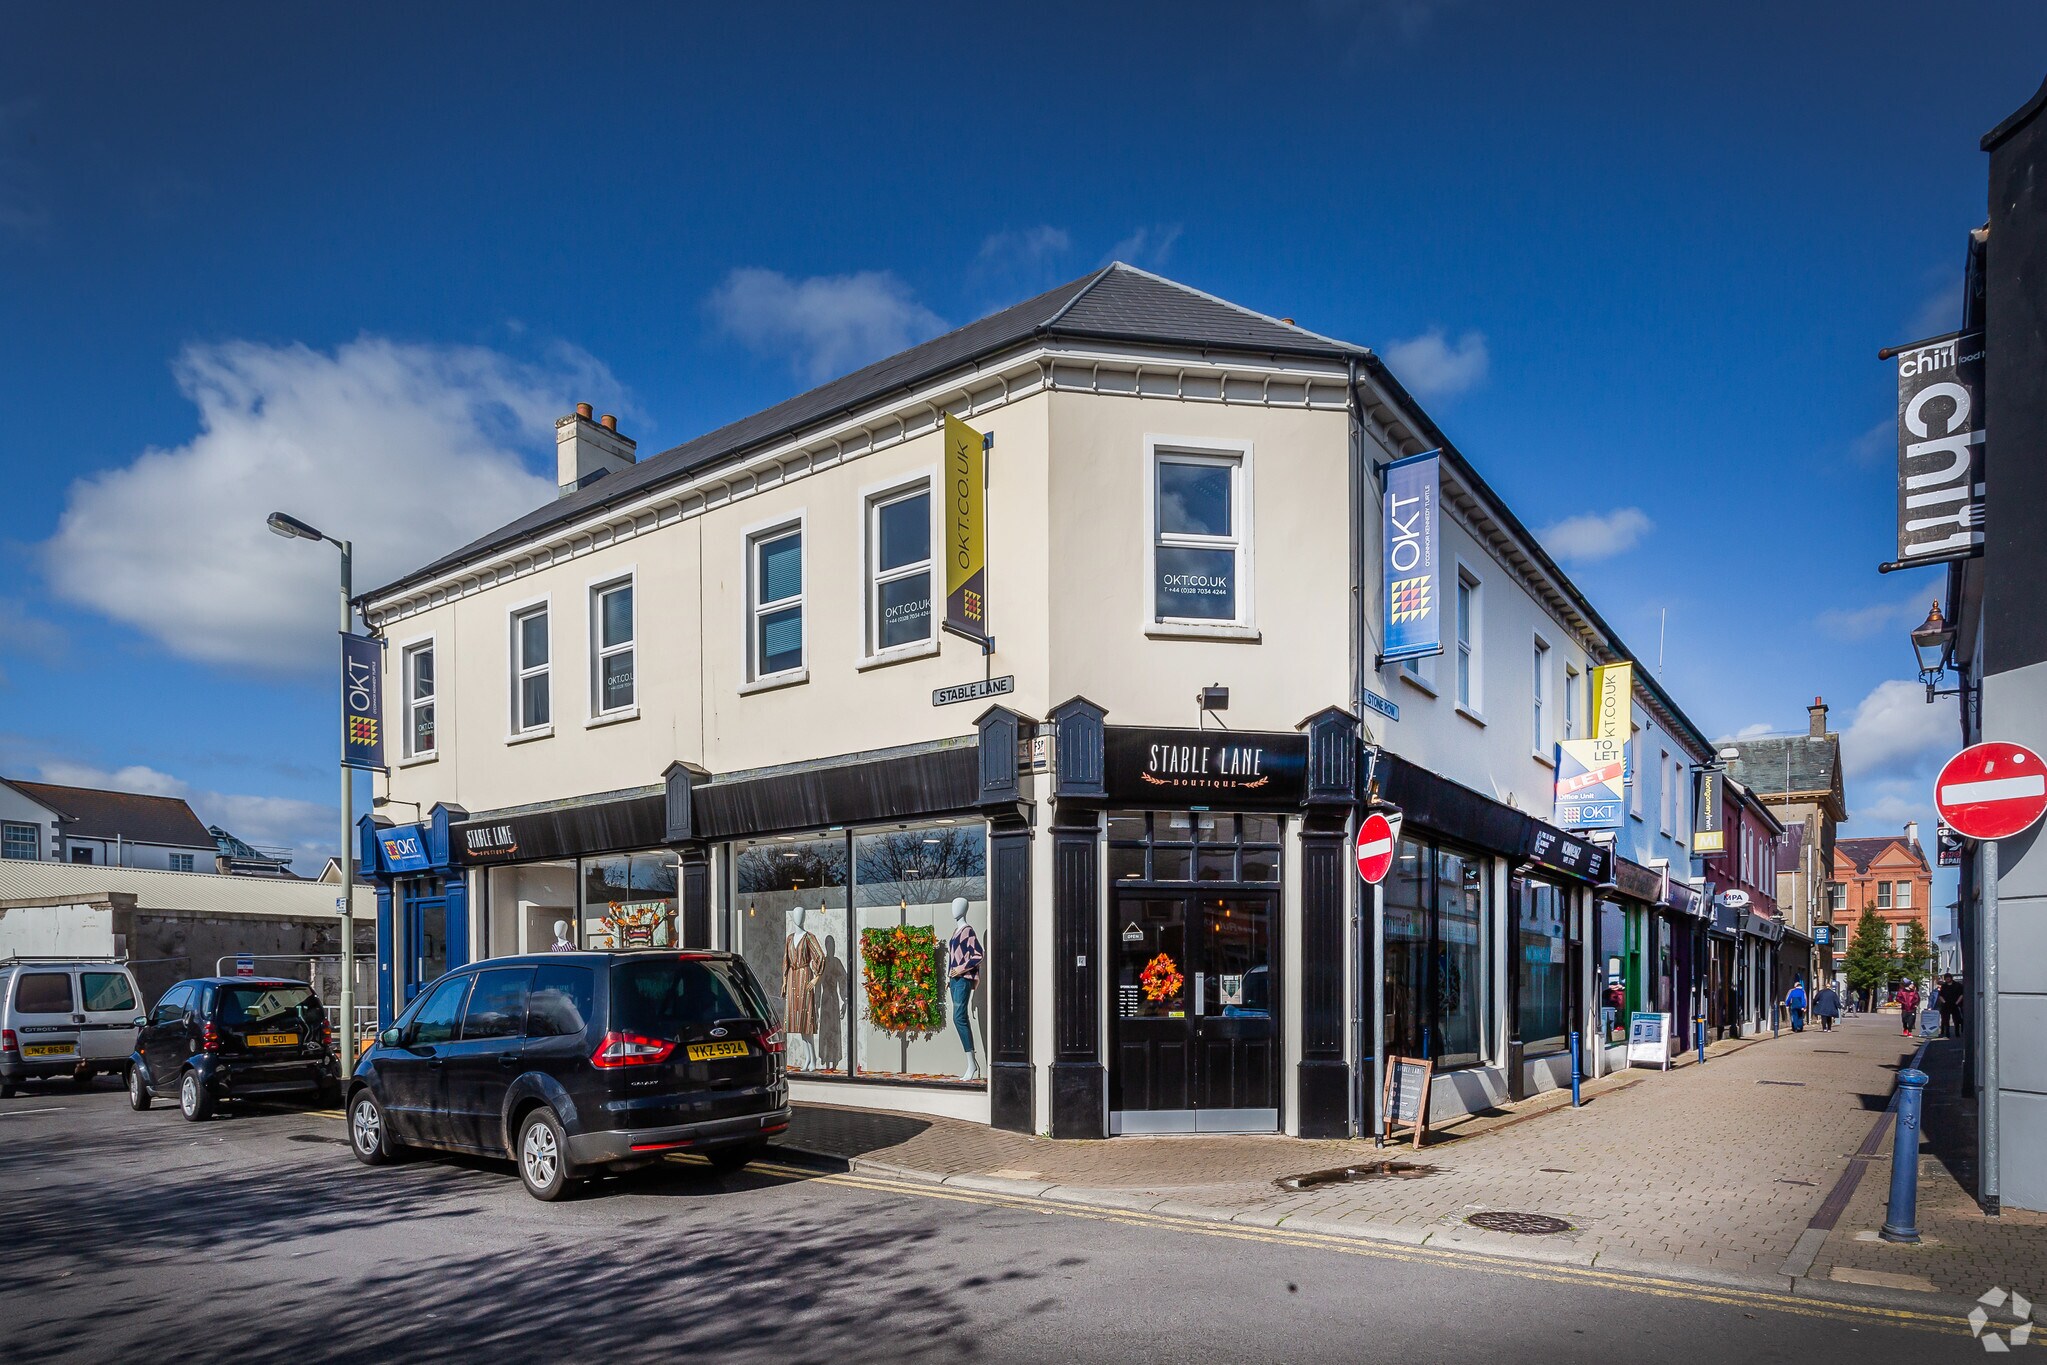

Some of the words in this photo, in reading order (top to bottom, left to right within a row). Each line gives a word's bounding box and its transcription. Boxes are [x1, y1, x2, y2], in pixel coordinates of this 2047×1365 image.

[957, 439, 970, 570] OKT.CO.UK
[1391, 493, 1421, 571] OKT
[1163, 574, 1227, 587] OKT.CO.UK
[885, 598, 931, 618] OKT.CO.UK
[349, 655, 371, 711] OKT
[938, 684, 977, 703] STABLE
[978, 679, 1007, 697] LANE
[1367, 693, 1384, 711] STONE
[1384, 701, 1395, 717] ROW
[1604, 674, 1617, 738] KT.CO.UK
[1594, 740, 1613, 750] TO
[1149, 745, 1211, 775] STABLE
[1220, 747, 1263, 776] LANE
[1594, 750, 1619, 761] LET
[1173, 778, 1237, 789] BOUTIQUE
[1568, 768, 1607, 790] LET
[1580, 792, 1595, 800] Unit
[1583, 805, 1615, 819] OKT
[396, 838, 418, 855] OKT
[466, 828, 494, 848] STABLE
[492, 825, 514, 846] LANE
[272, 1035, 287, 1044] 501
[692, 1045, 717, 1058] YKZ
[718, 1042, 744, 1056] 5924
